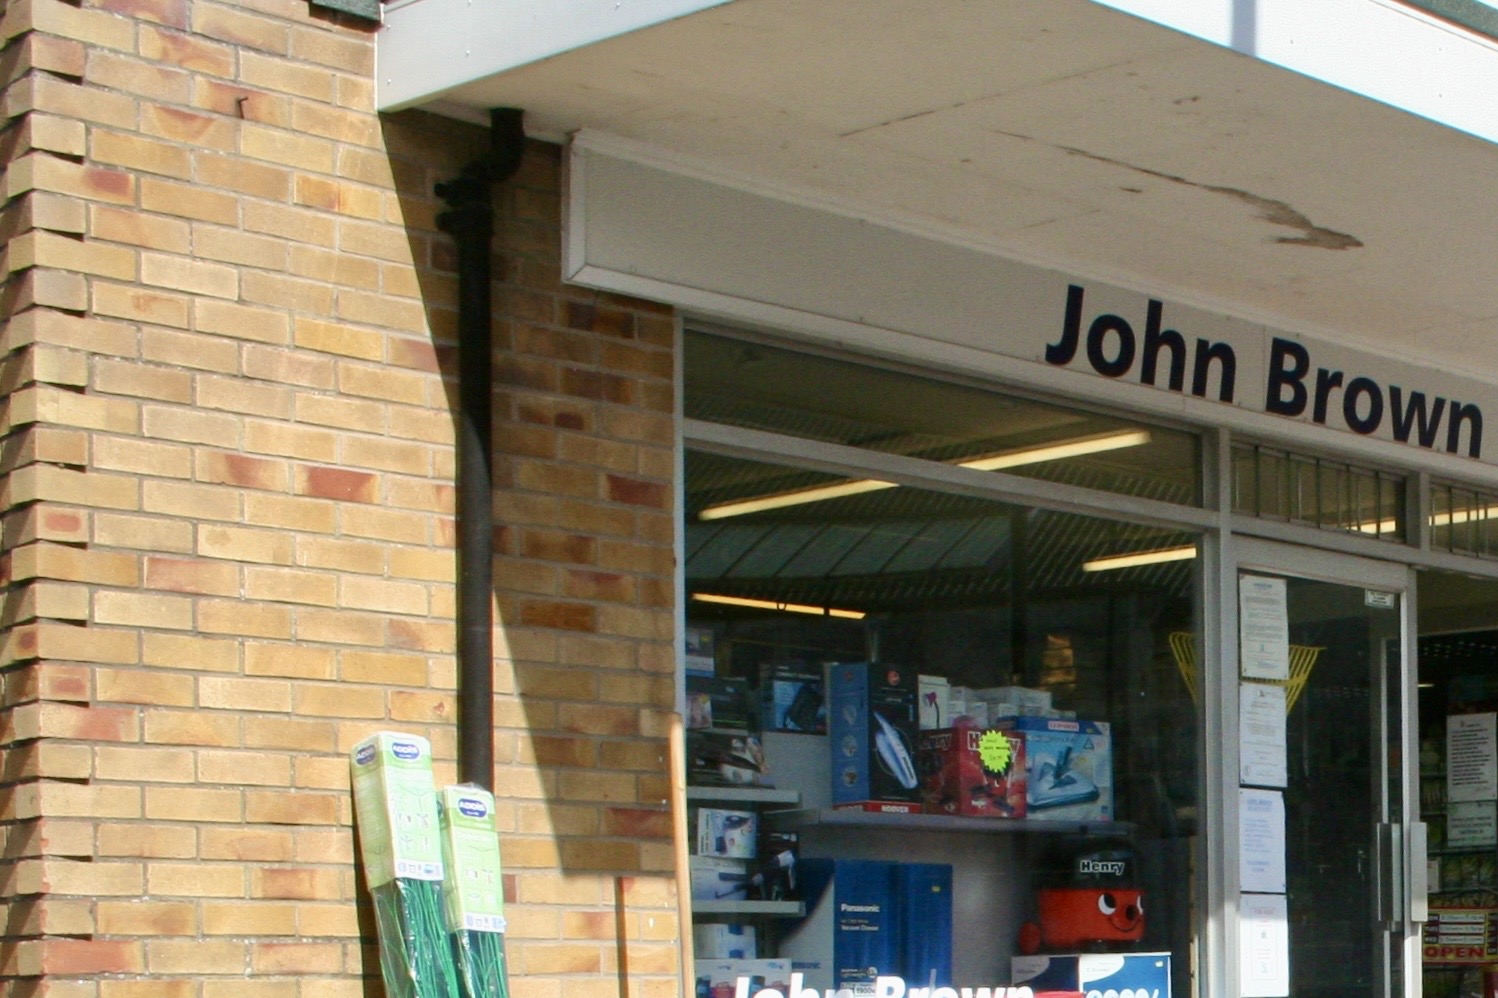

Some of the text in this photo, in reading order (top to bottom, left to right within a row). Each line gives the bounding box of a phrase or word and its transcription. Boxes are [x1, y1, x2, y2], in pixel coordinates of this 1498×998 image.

[1045, 285, 1236, 403] John
[1265, 337, 1484, 458] Brown
[1080, 859, 1125, 876] Henry
[840, 903, 880, 912] Panasonic
[1424, 946, 1484, 958] OPEN
